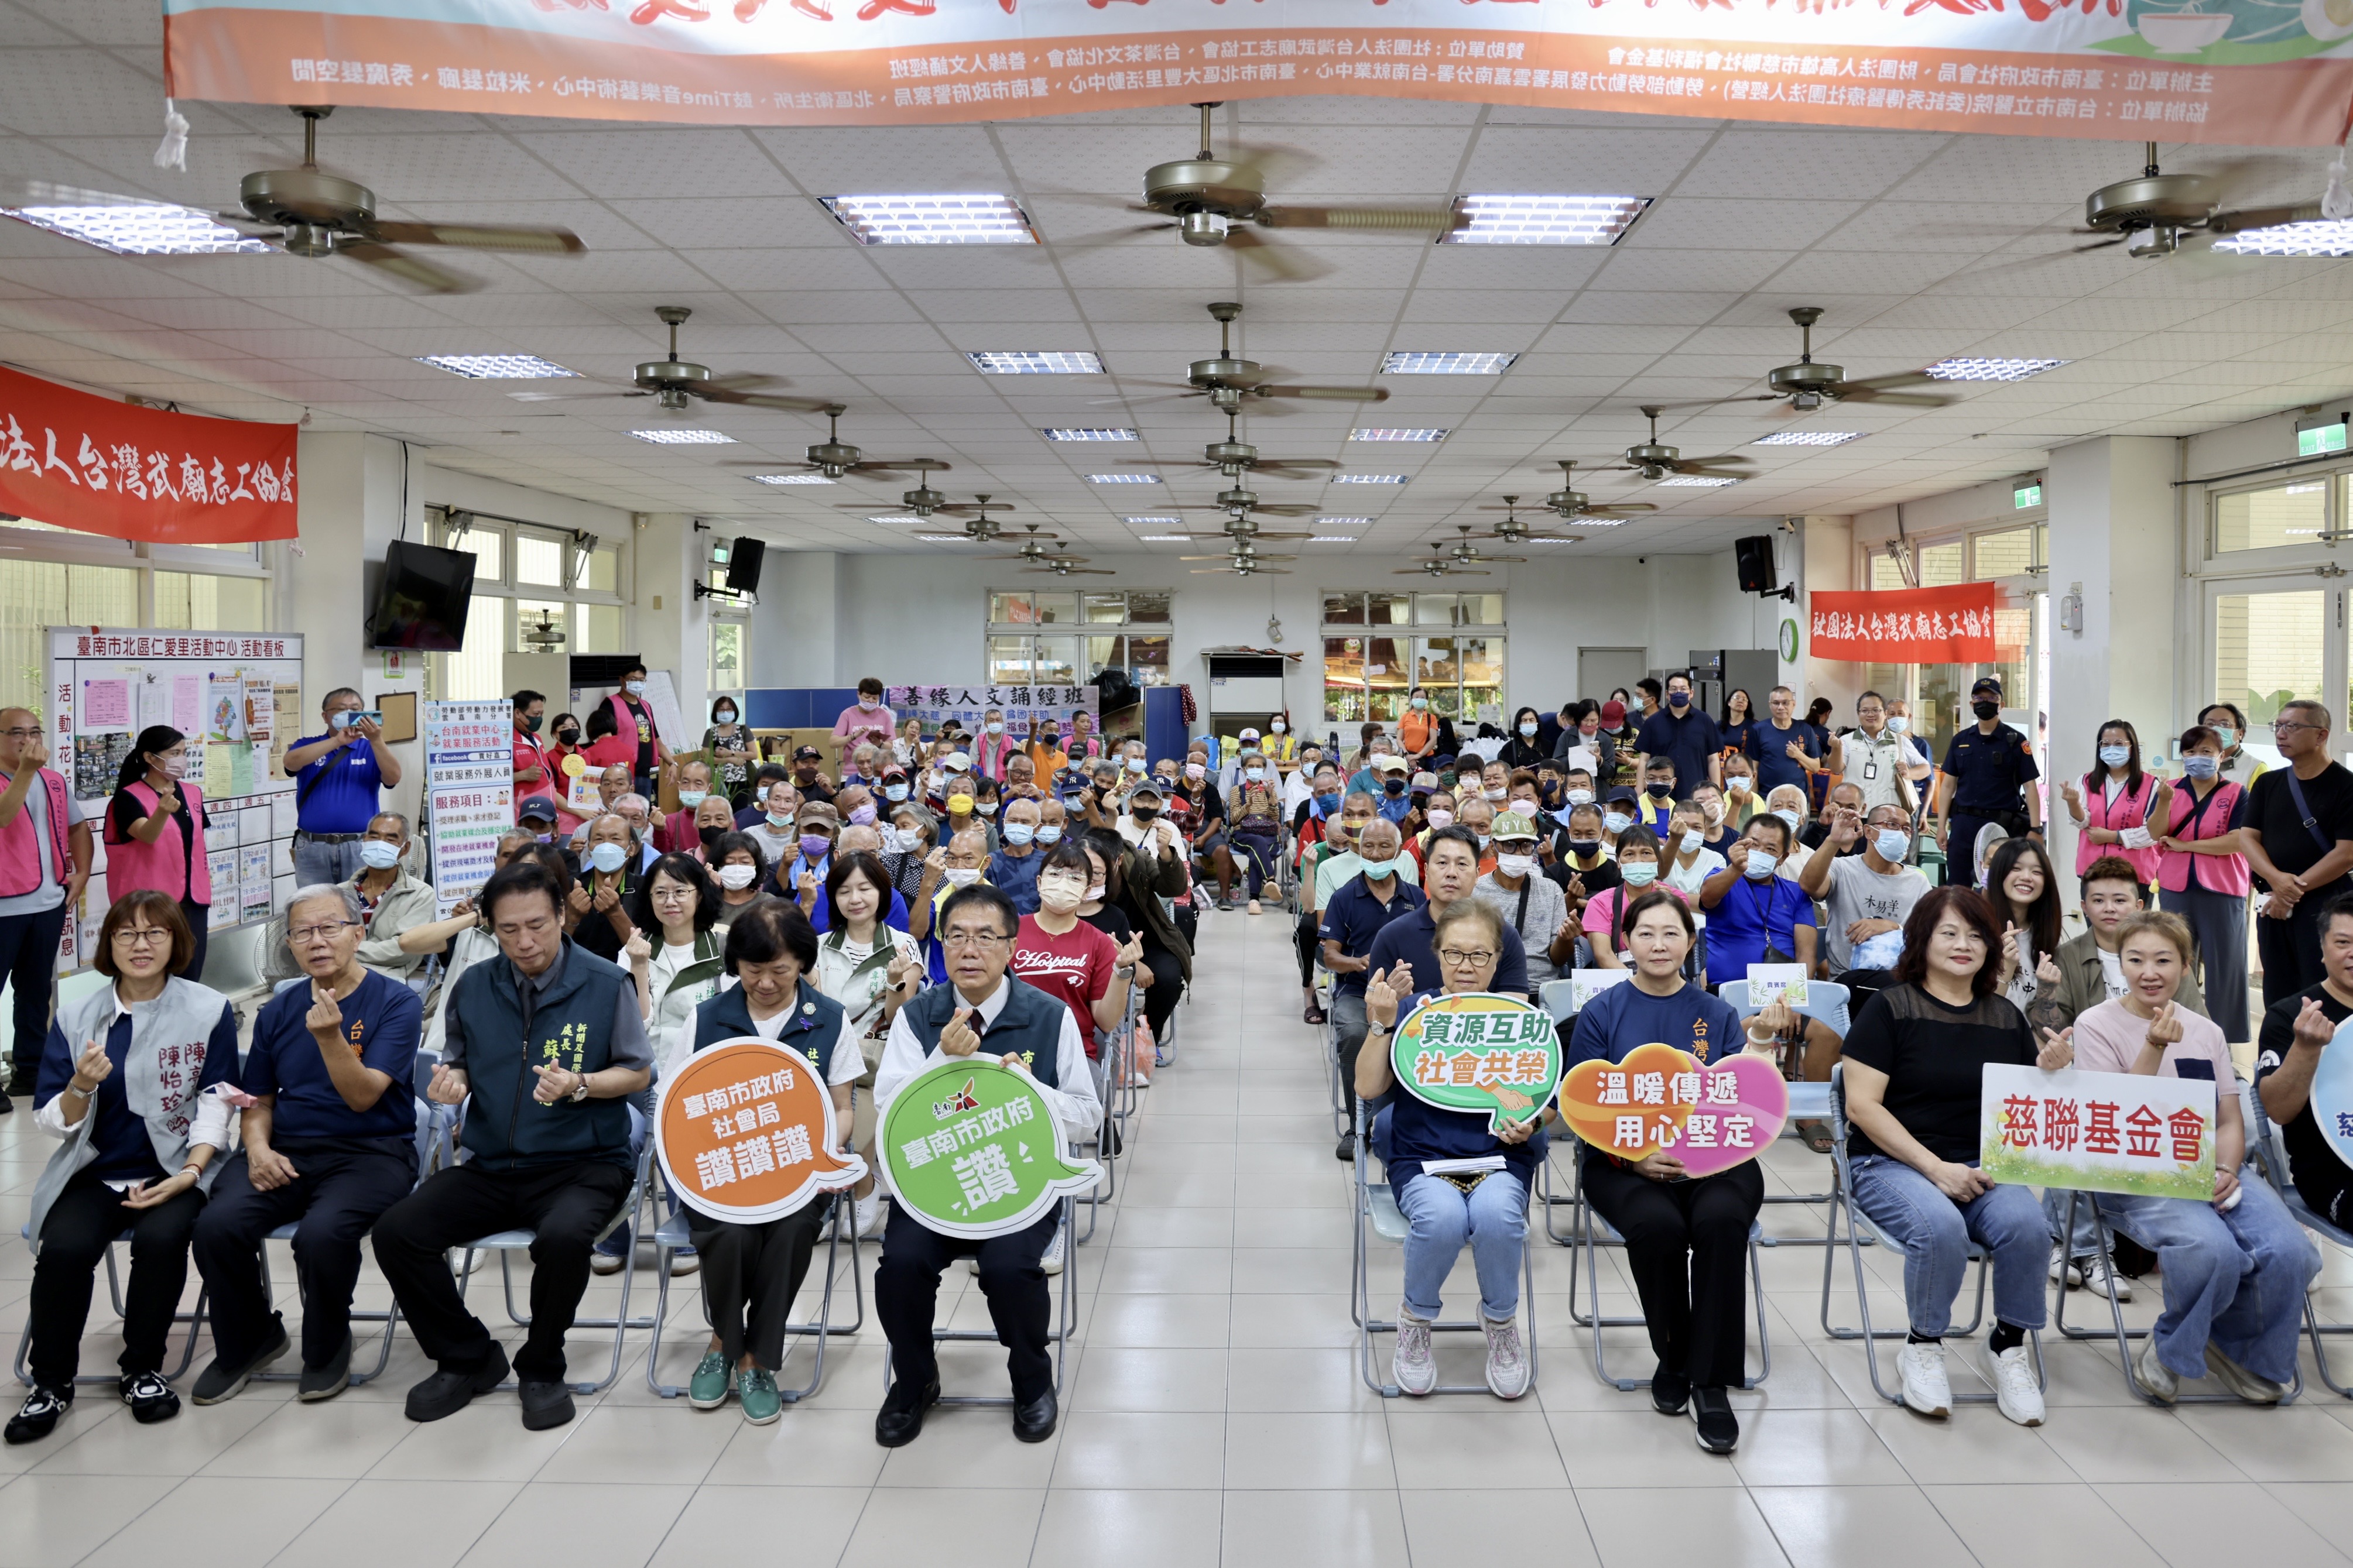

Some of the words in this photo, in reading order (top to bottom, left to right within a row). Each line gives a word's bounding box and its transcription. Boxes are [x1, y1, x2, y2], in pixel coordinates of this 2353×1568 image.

[1811, 606, 1991, 642] 社團法人台灣武廟志工協會
[77, 636, 238, 657] 臺南市北區仁愛里活動中心
[241, 640, 285, 657] 活動看板
[903, 686, 1085, 707] 善緣人文誦經班
[442, 713, 511, 721] 雲嘉南分署
[442, 725, 499, 736] 台南就業中心
[443, 737, 500, 749] 就業服務活動
[434, 767, 511, 781] 就業服務外展人員
[210, 801, 231, 812] 週四
[244, 797, 265, 806] 週五
[1502, 820, 1530, 833] NYC
[1863, 895, 1899, 914] 木易羊
[1014, 949, 1088, 970] Hospital
[560, 1023, 574, 1051] 處長
[1421, 1011, 1552, 1046] 資源互助
[158, 1045, 183, 1113] 陳怡珍
[1414, 1050, 1549, 1086] 社會共榮
[682, 1068, 796, 1120] 臺南市政府
[1597, 1071, 1739, 1106] 溫暖傳遞
[712, 1101, 781, 1140] 社會局
[900, 1094, 1034, 1169] 臺南市政府
[1612, 1114, 1755, 1148] 用心堅定
[2001, 1093, 2205, 1163] 慈聯基金會
[694, 1123, 814, 1192] 讚讚讚
[951, 1143, 1020, 1212] 讚
